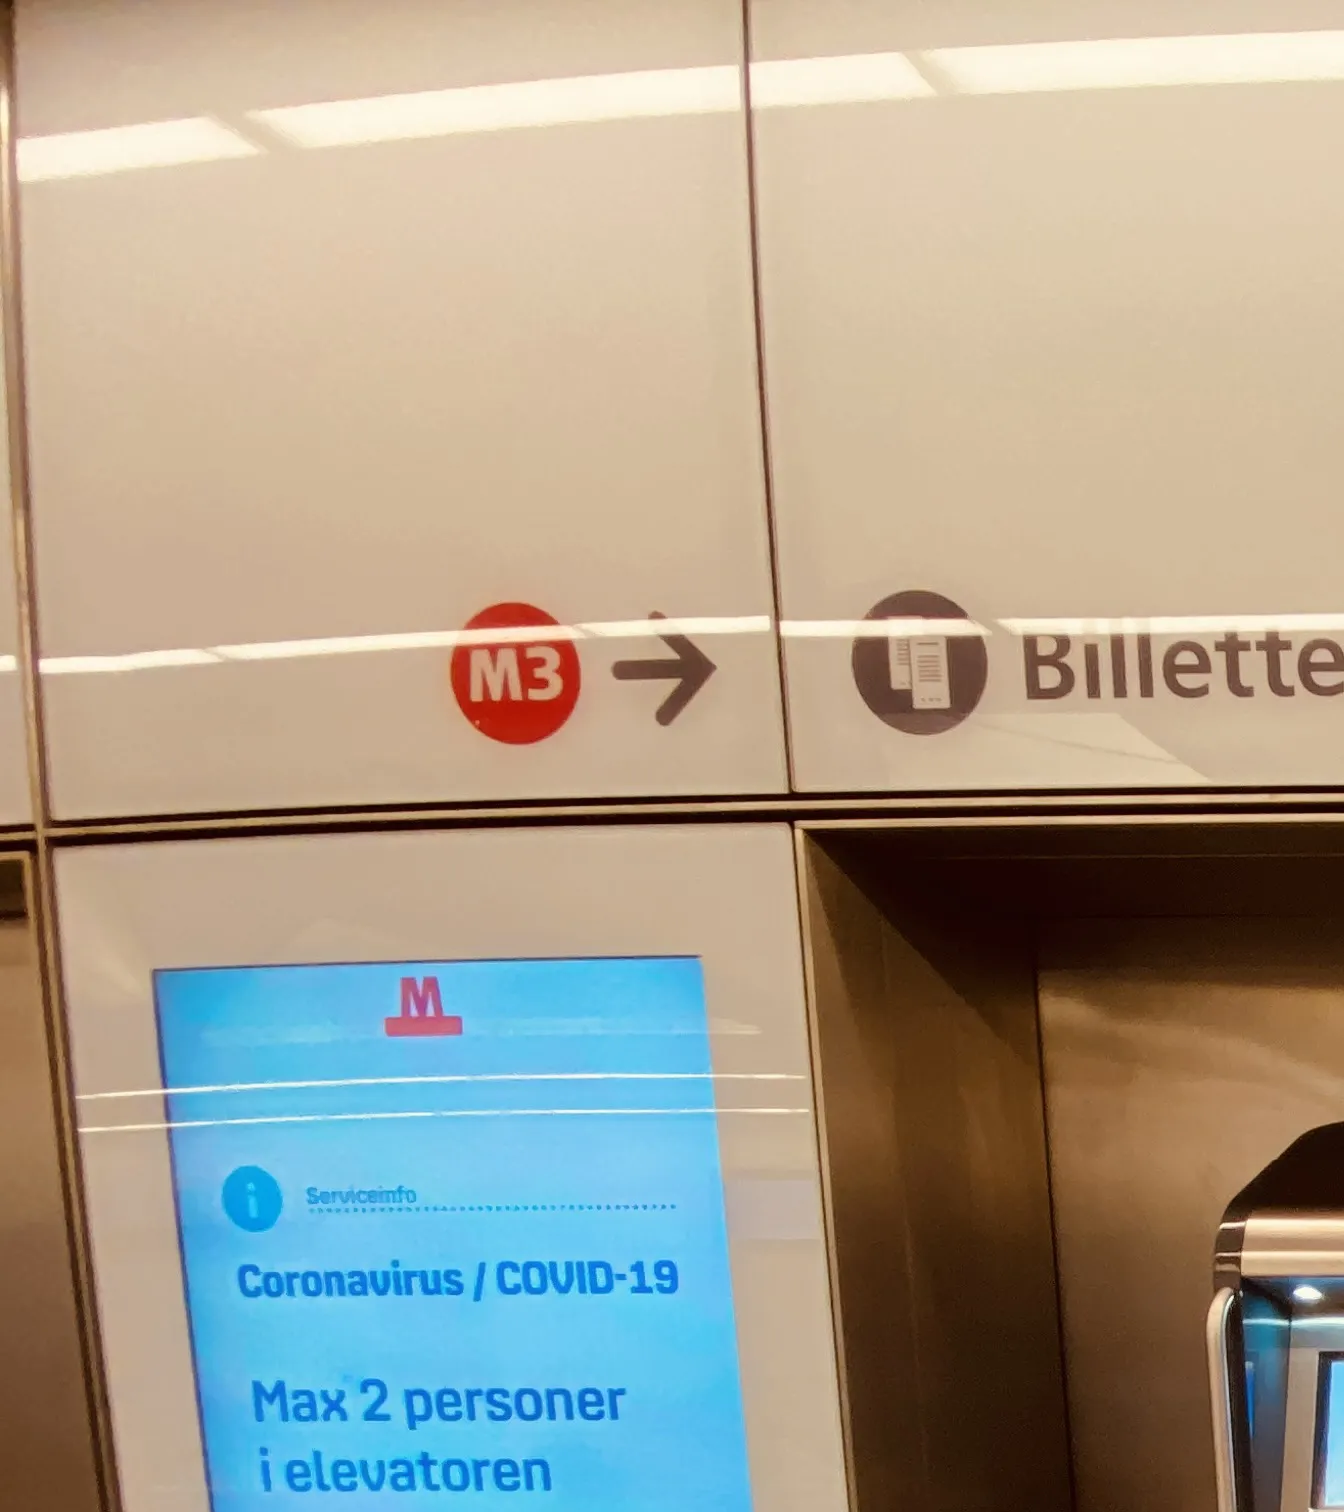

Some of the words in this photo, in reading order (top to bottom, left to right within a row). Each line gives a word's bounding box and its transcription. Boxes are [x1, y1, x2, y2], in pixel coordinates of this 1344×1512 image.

[469, 645, 564, 703] M3
[400, 976, 444, 1018] M
[306, 1185, 417, 1205] Serviceinfo
[237, 1259, 465, 1299] Coronavirus
[473, 1261, 487, 1303] /
[496, 1259, 680, 1297] COVID-19
[251, 1379, 348, 1423] Max
[359, 1378, 392, 1422] 2
[403, 1384, 626, 1431] personer
[259, 1446, 273, 1493] i
[285, 1449, 552, 1493] elevatoren
